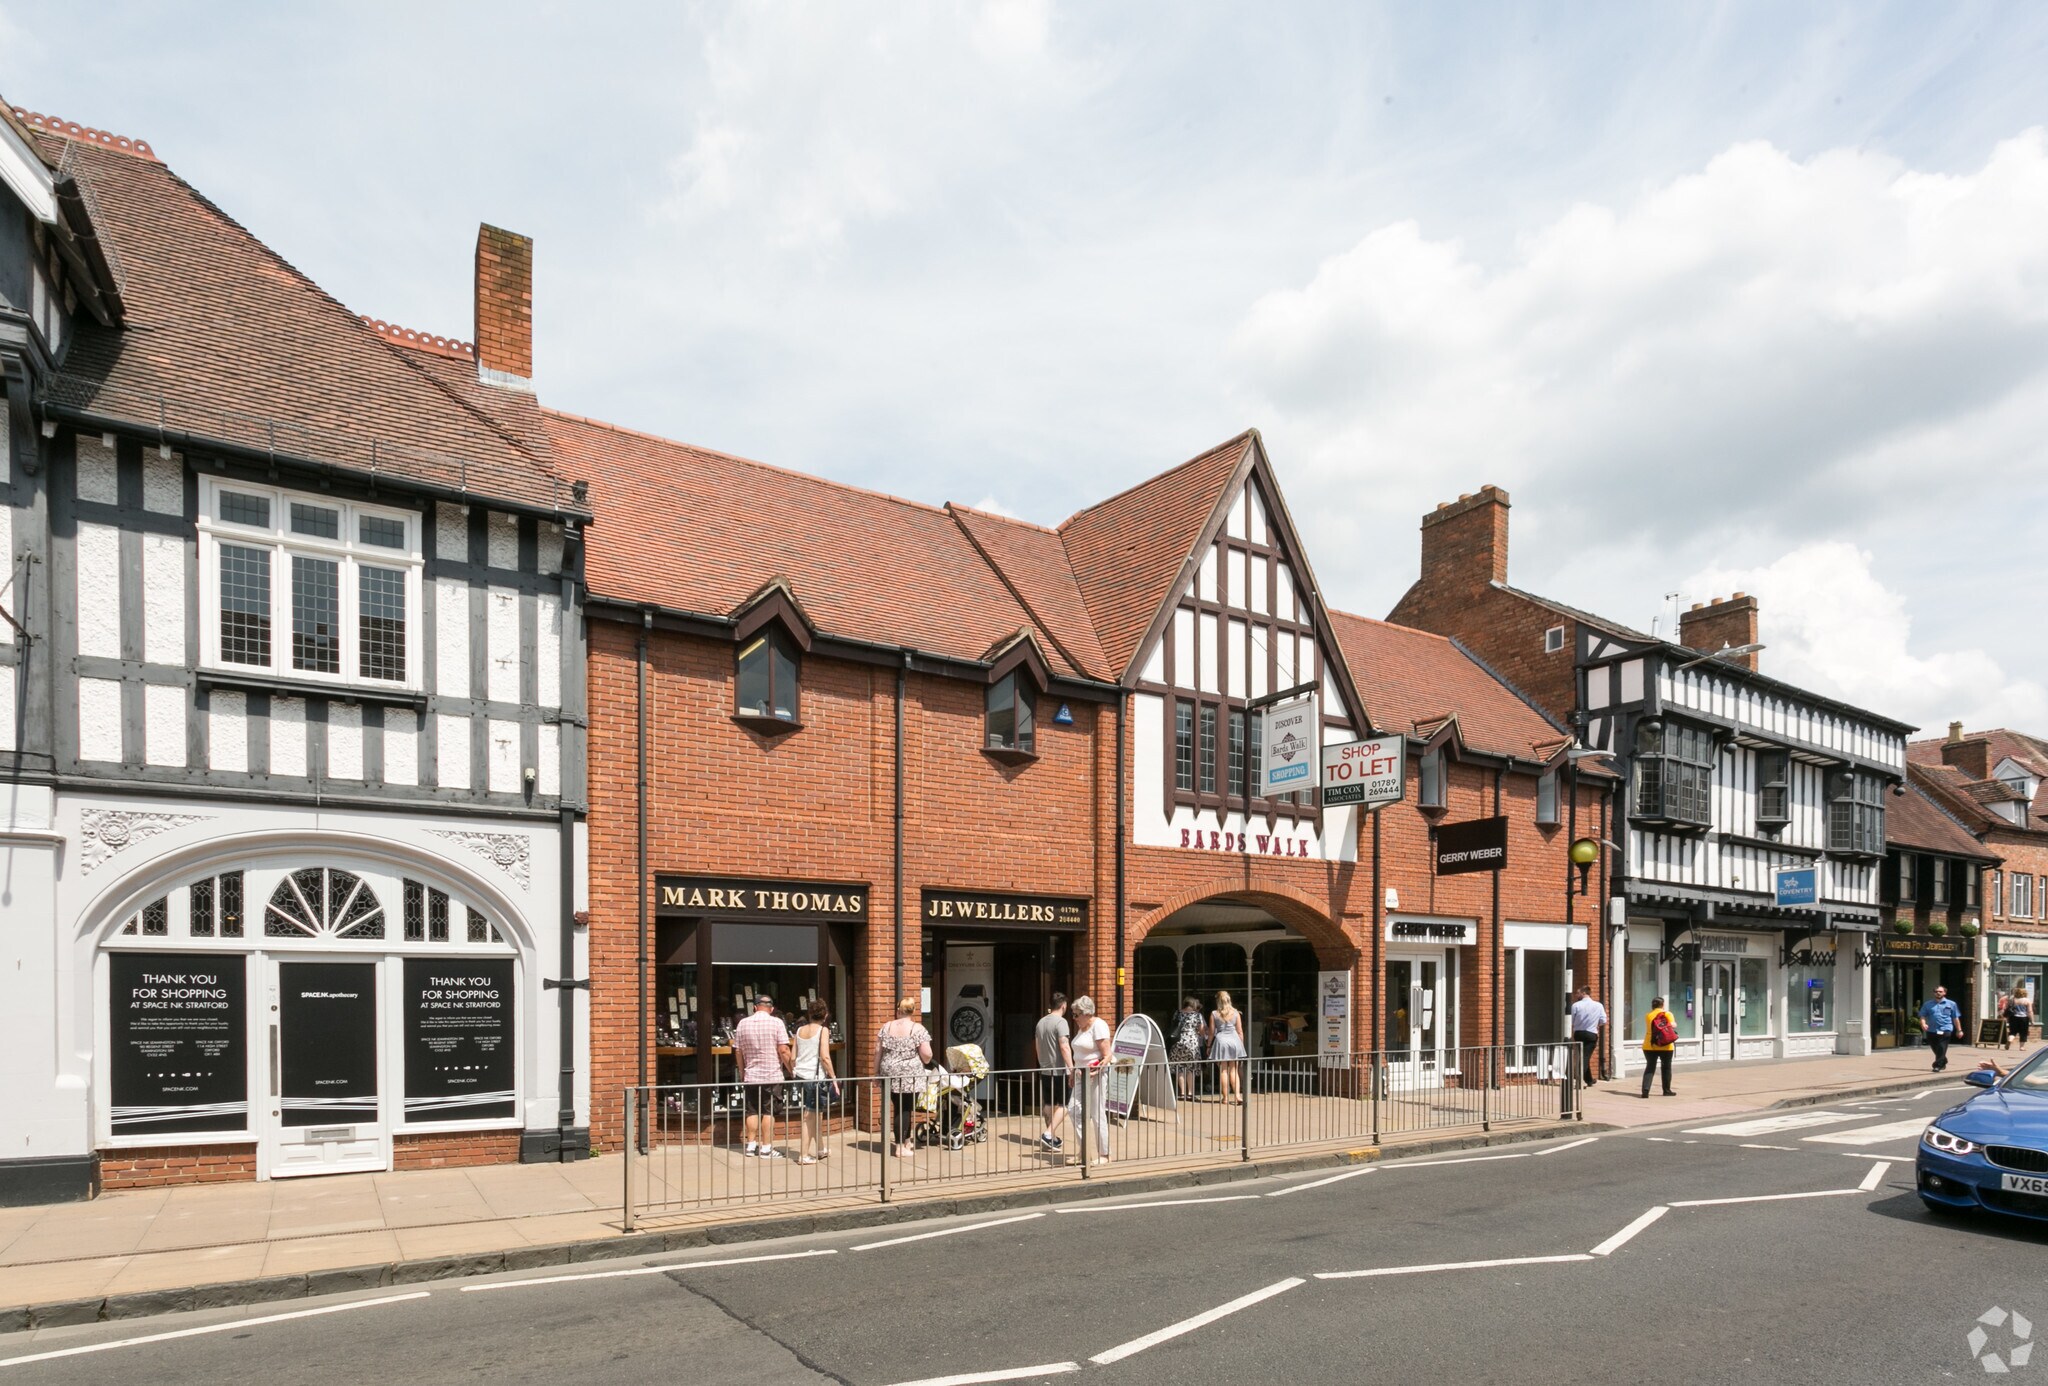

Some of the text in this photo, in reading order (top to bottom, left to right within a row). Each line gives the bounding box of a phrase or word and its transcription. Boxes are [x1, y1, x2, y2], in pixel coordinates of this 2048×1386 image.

[1275, 715, 1302, 730] DISCOVER
[1272, 740, 1306, 755] Bards Walk
[1342, 743, 1380, 759] SHOP
[1272, 765, 1306, 780] SHOPPING
[1326, 756, 1397, 781] TO LET
[1327, 786, 1361, 796] TIM COX
[1369, 786, 1399, 796] 269444
[1372, 779, 1396, 788] 01789
[1180, 828, 1309, 856] BARDS WALK
[1440, 847, 1502, 864] GERRY WEBER
[662, 886, 861, 913] MARK THOMAS
[929, 900, 1054, 922] JEWELLERS
[1701, 935, 1748, 952] COVENTRY
[142, 974, 217, 984] THANK YOU
[430, 977, 491, 986] THANK YOU
[132, 989, 226, 999] FOR SHOPPING
[422, 990, 499, 999] FOR SHOPPING
